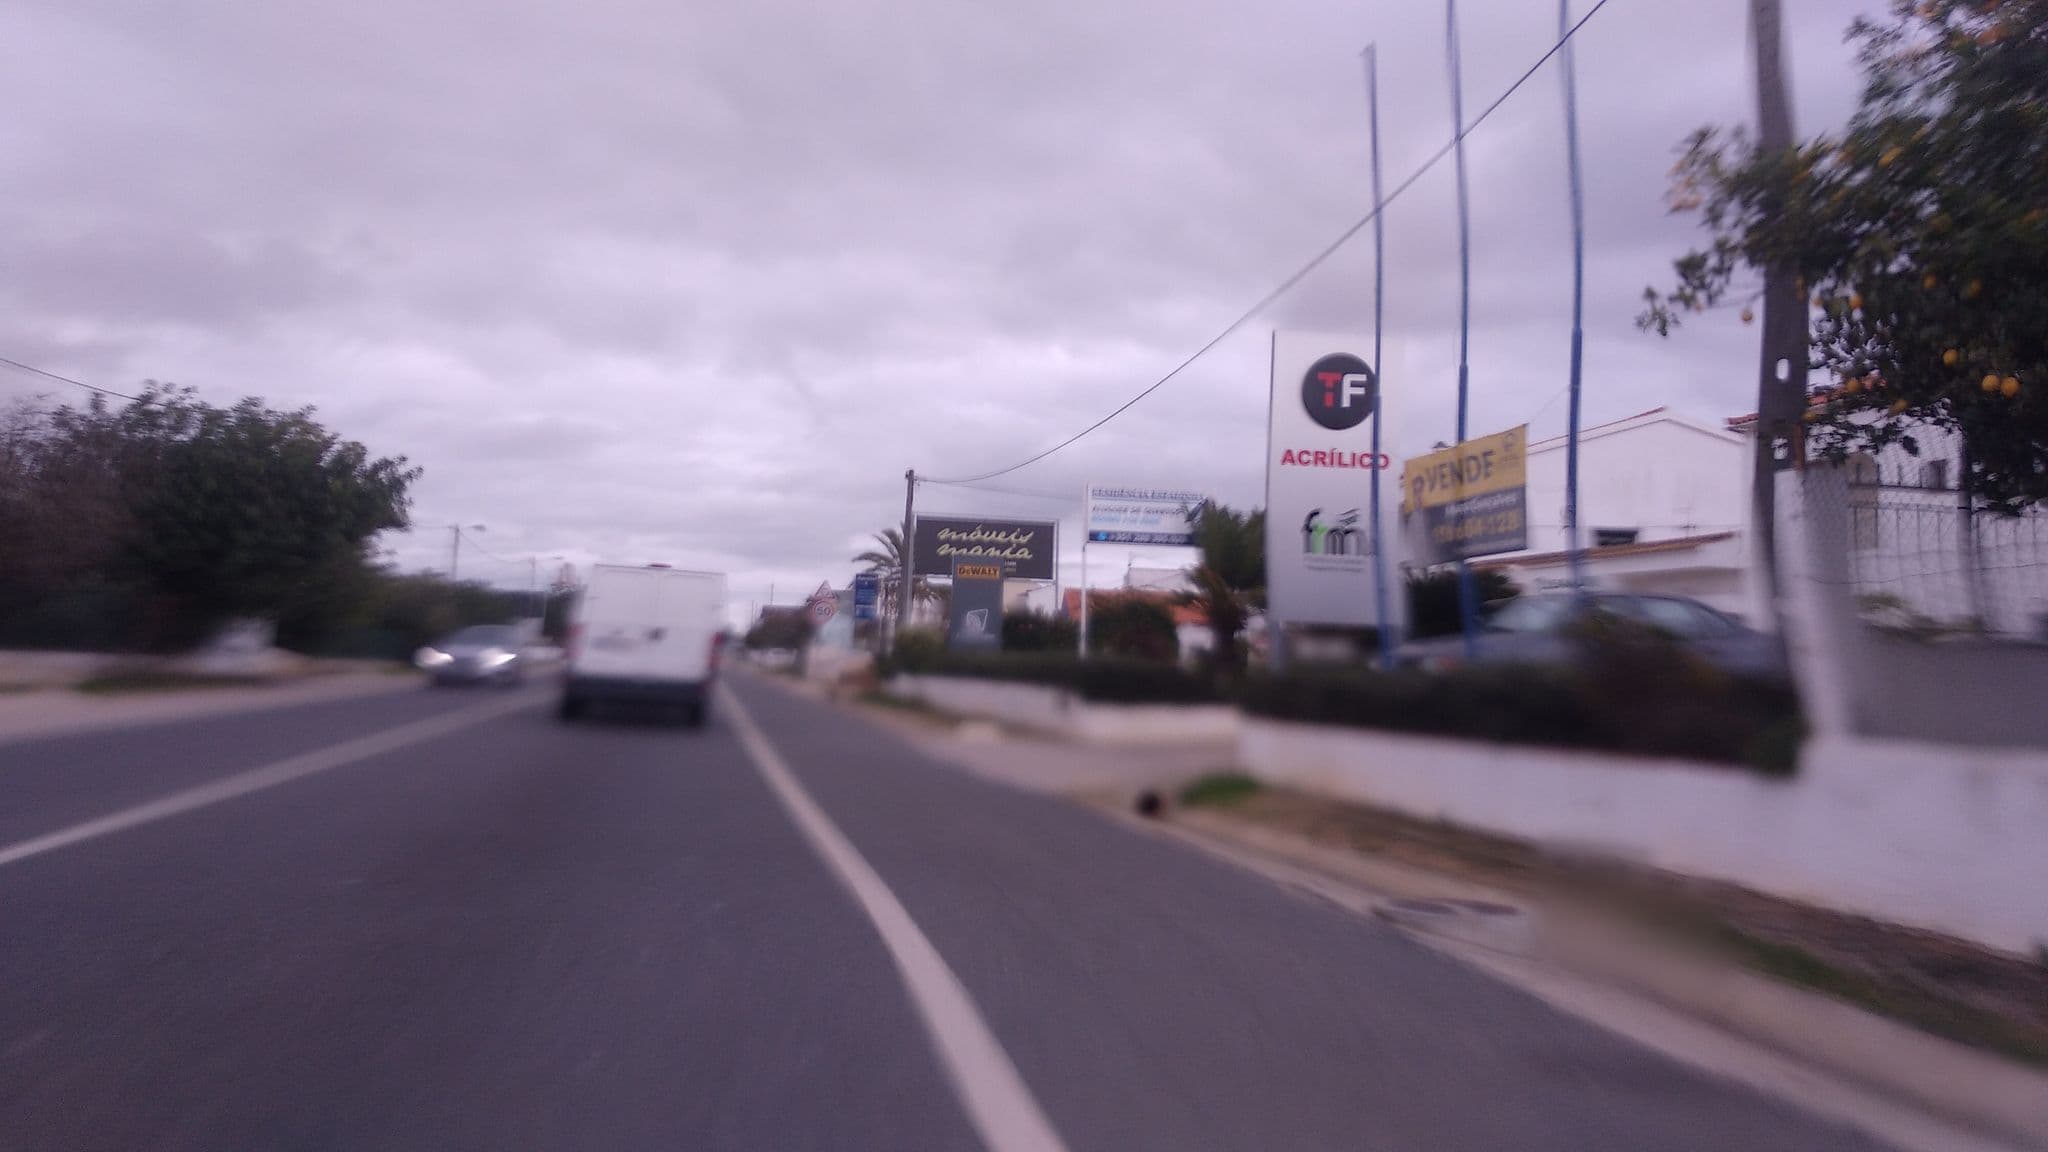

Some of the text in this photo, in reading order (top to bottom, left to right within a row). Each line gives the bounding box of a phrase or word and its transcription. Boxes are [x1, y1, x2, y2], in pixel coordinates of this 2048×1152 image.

[1317, 371, 1367, 408] TF
[1282, 448, 1390, 470] ACRÍLICO
[1423, 448, 1497, 492] VENDE
[936, 543, 1033, 559] mania
